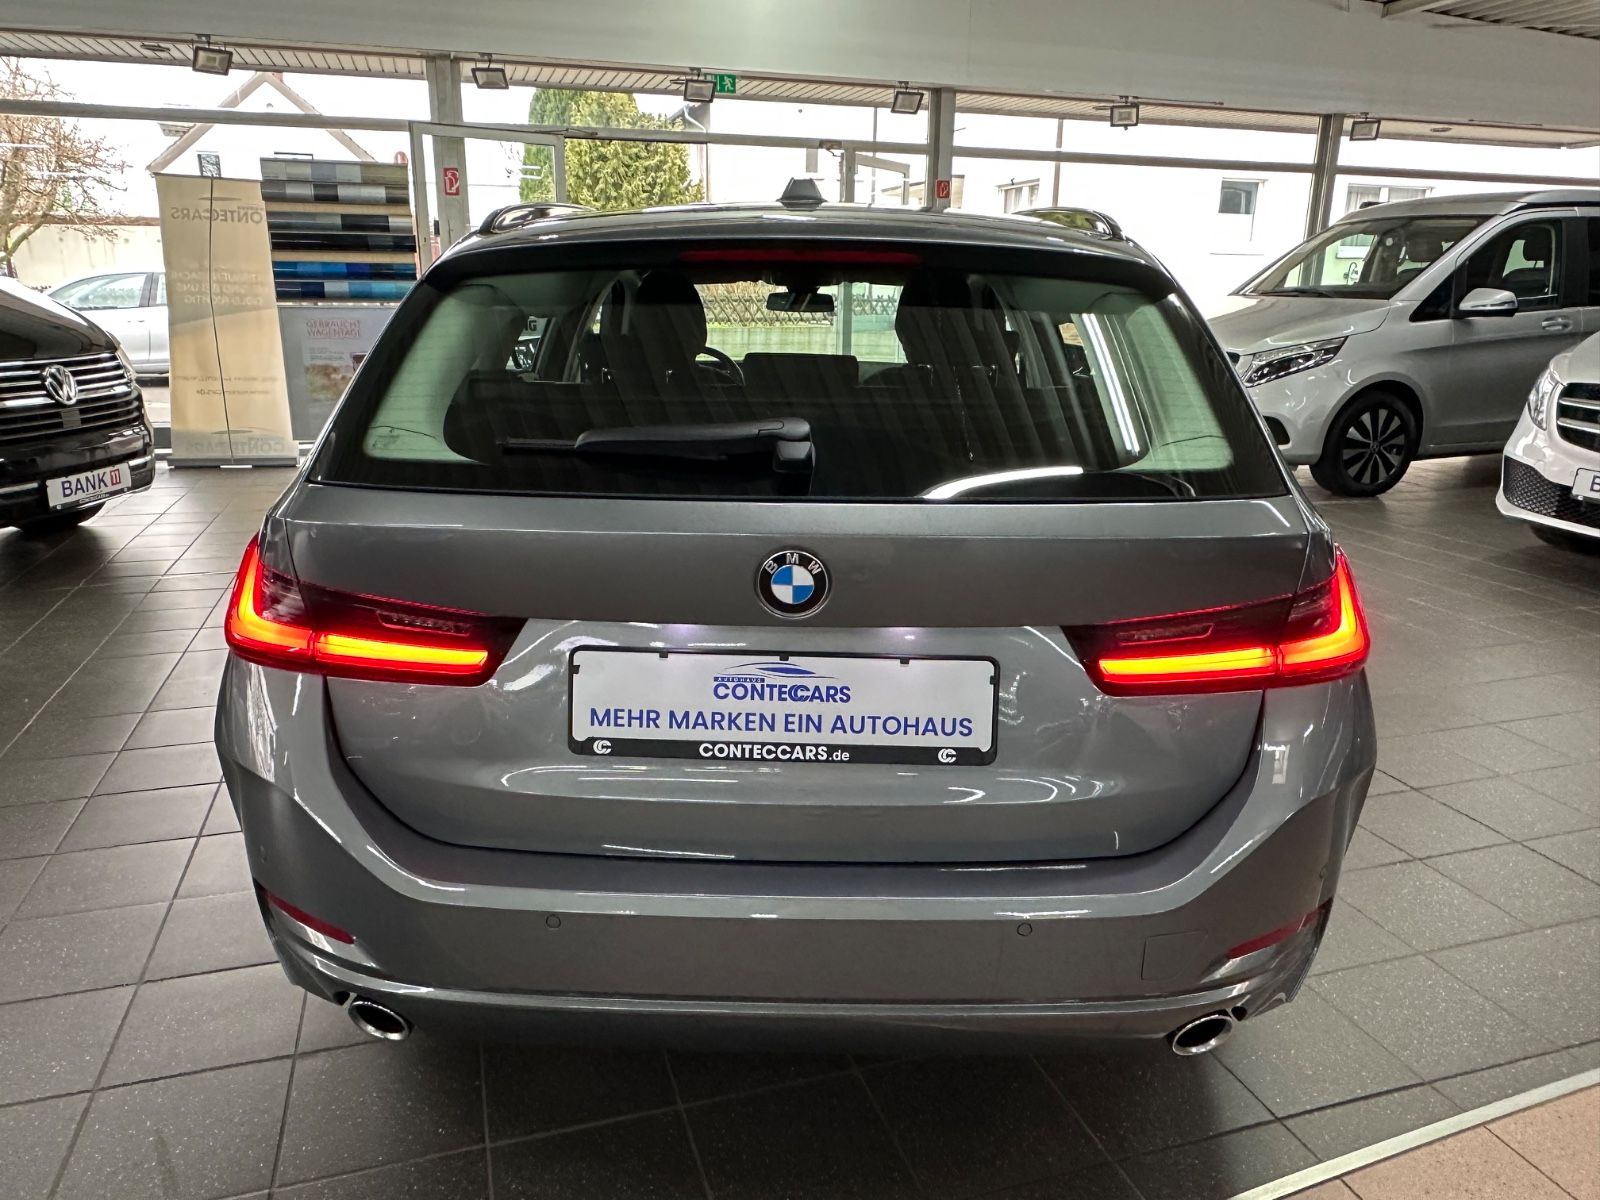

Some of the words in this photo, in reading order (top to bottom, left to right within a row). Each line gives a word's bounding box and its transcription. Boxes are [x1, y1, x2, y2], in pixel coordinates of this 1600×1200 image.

[61, 471, 108, 498] BANK
[764, 552, 822, 575] BMW
[713, 683, 851, 703] CONTECCARS
[590, 707, 661, 729] MEHR
[668, 710, 776, 732] MARKEN
[784, 713, 822, 733] EIN
[830, 714, 973, 737] AUTOHAUS
[699, 742, 850, 761] CONTECCARS.de
